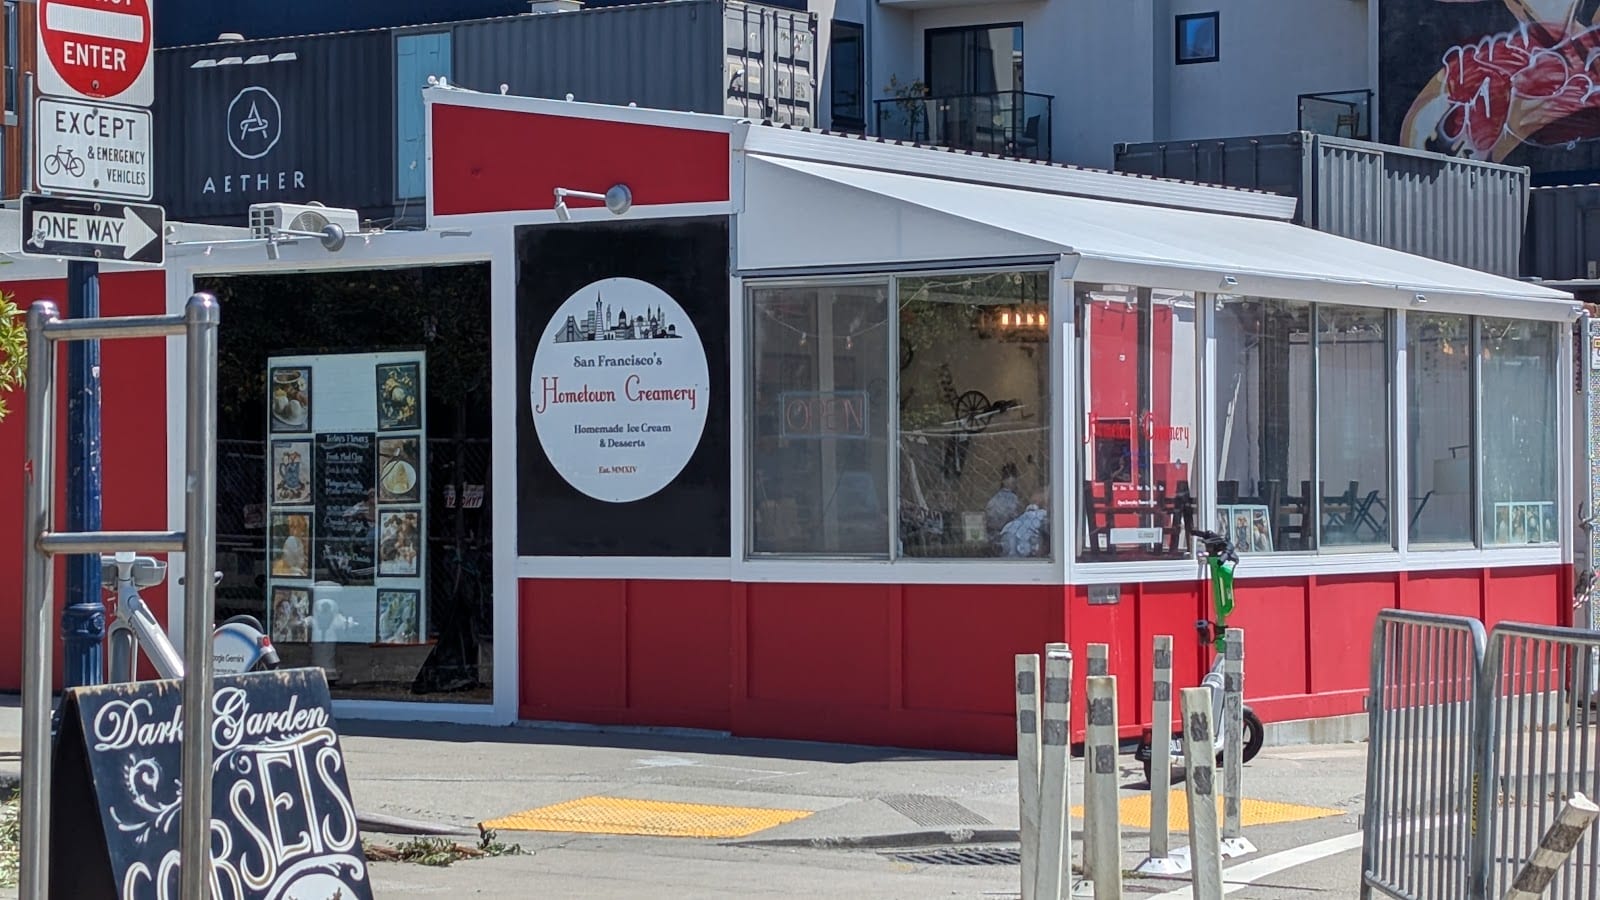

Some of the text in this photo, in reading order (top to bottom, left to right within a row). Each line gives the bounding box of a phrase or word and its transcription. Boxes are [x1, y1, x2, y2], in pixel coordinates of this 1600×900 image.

[63, 42, 126, 71] ENTER
[55, 110, 136, 140] EXCEPT
[87, 146, 146, 165] & EMERGENCY
[106, 168, 146, 186] VEHICLES
[202, 171, 306, 195] AETHER
[38, 215, 124, 243] ONE WAY
[573, 352, 663, 368] San Francisco's
[535, 374, 696, 414] Hometown Creamery
[574, 422, 672, 434] Homemade Ice Cream
[786, 399, 863, 433] OPEN
[599, 438, 646, 448] & Desserts
[94, 687, 329, 750] Dark Garden
[124, 744, 357, 900] RSETS
